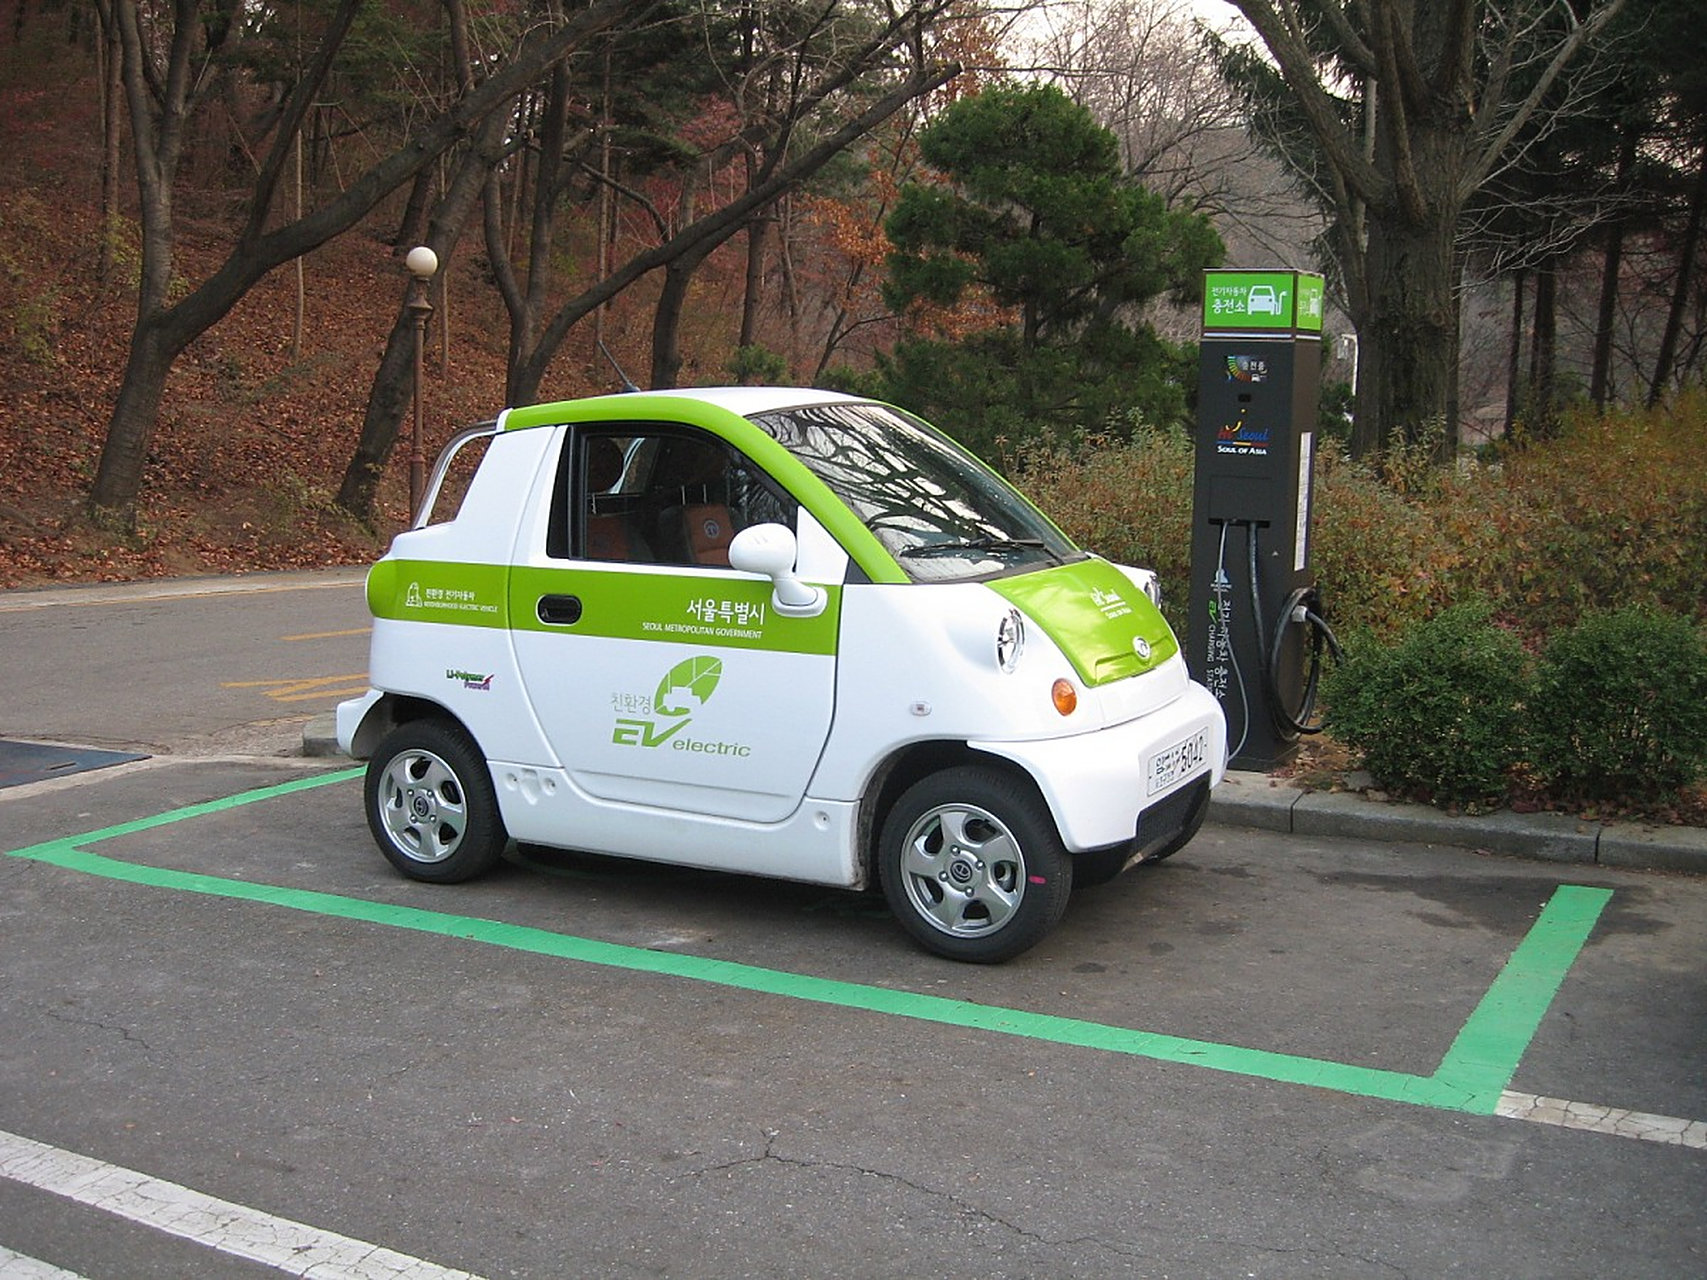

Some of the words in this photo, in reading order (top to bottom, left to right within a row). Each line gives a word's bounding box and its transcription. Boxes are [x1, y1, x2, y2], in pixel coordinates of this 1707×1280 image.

[1212, 286, 1247, 297] 전기자동차
[1211, 298, 1246, 315] 충전소
[686, 598, 765, 626] 서울특별시
[642, 622, 663, 632] SEOUL
[664, 624, 715, 636] METROPOLITAN
[715, 628, 763, 639] GOVERNMENT
[1207, 625, 1216, 662] CHARGING
[611, 692, 652, 715] 친환경
[612, 718, 693, 748] EV
[672, 738, 752, 758] electric
